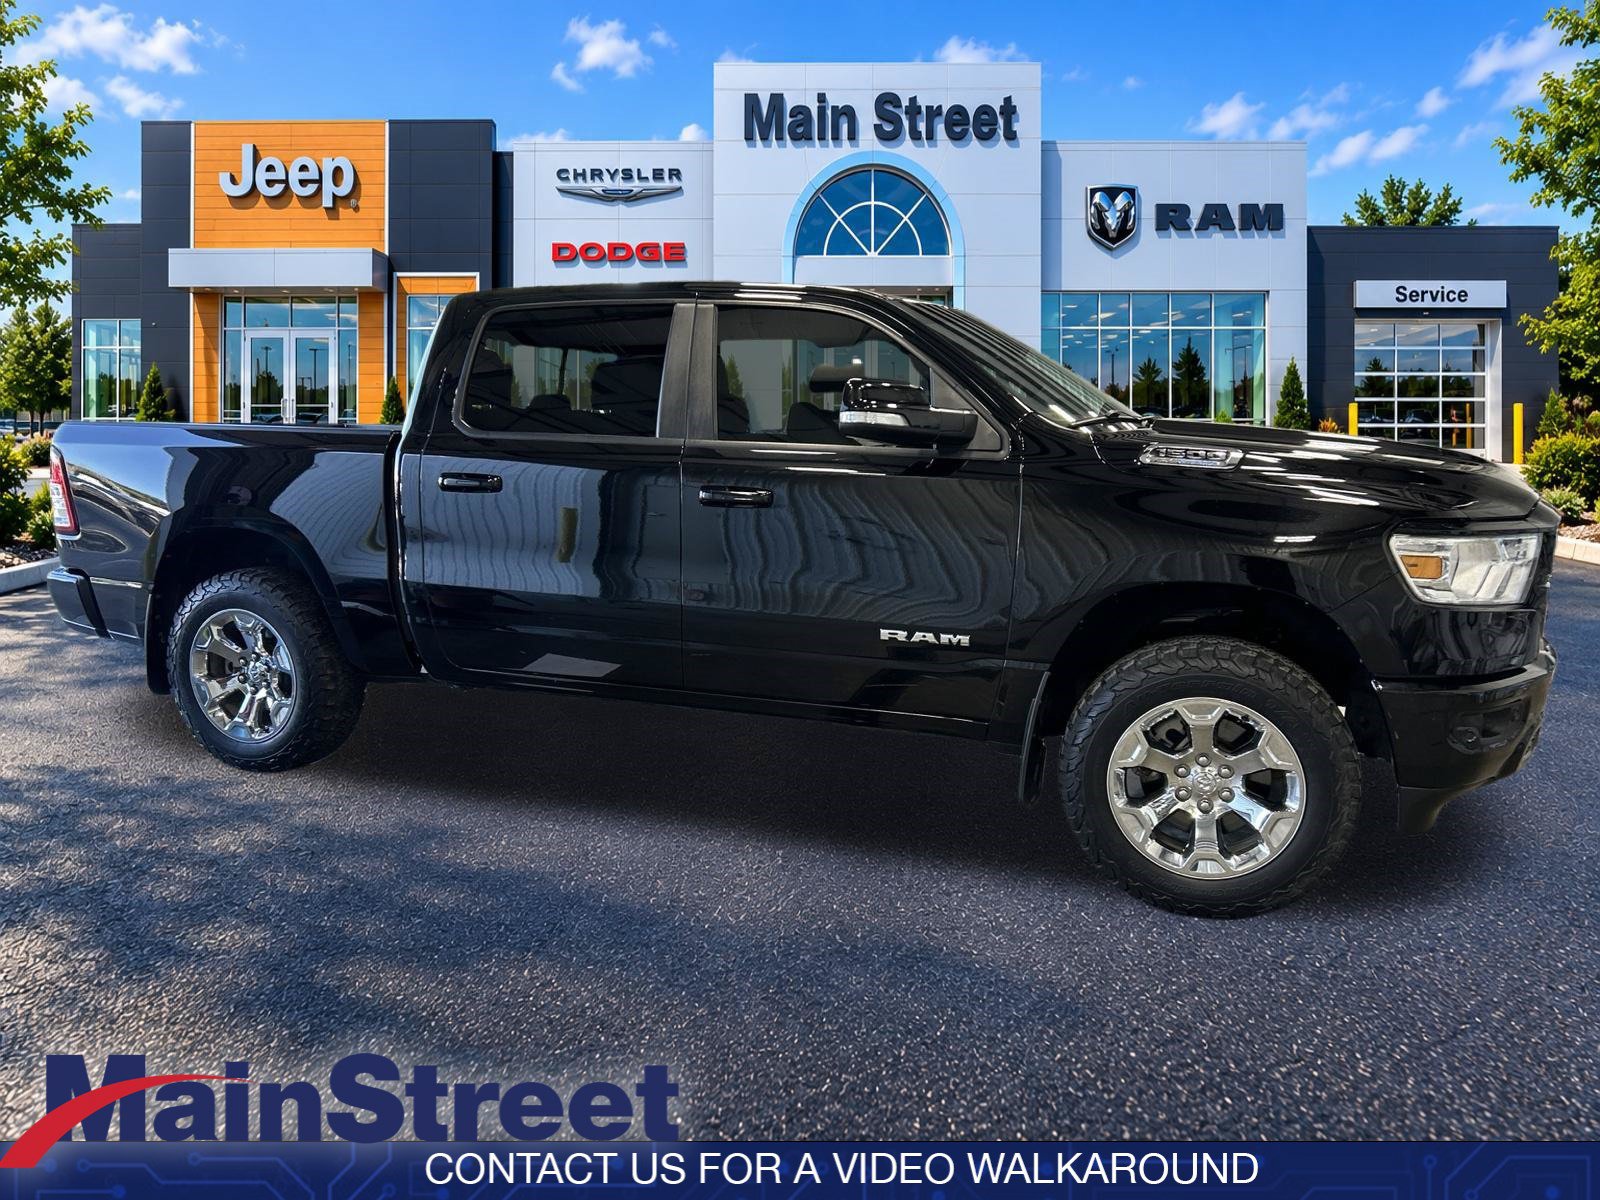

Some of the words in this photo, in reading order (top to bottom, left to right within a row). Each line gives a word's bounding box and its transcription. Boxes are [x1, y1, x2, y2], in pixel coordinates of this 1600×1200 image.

[744, 93, 857, 141] Main
[873, 92, 1017, 141] Street
[219, 143, 355, 208] Jeep
[556, 168, 682, 182] CHRYSLER
[1155, 203, 1284, 231] RAM
[551, 242, 686, 261] DODGE
[1395, 285, 1469, 303] Service
[879, 628, 971, 647] RAM
